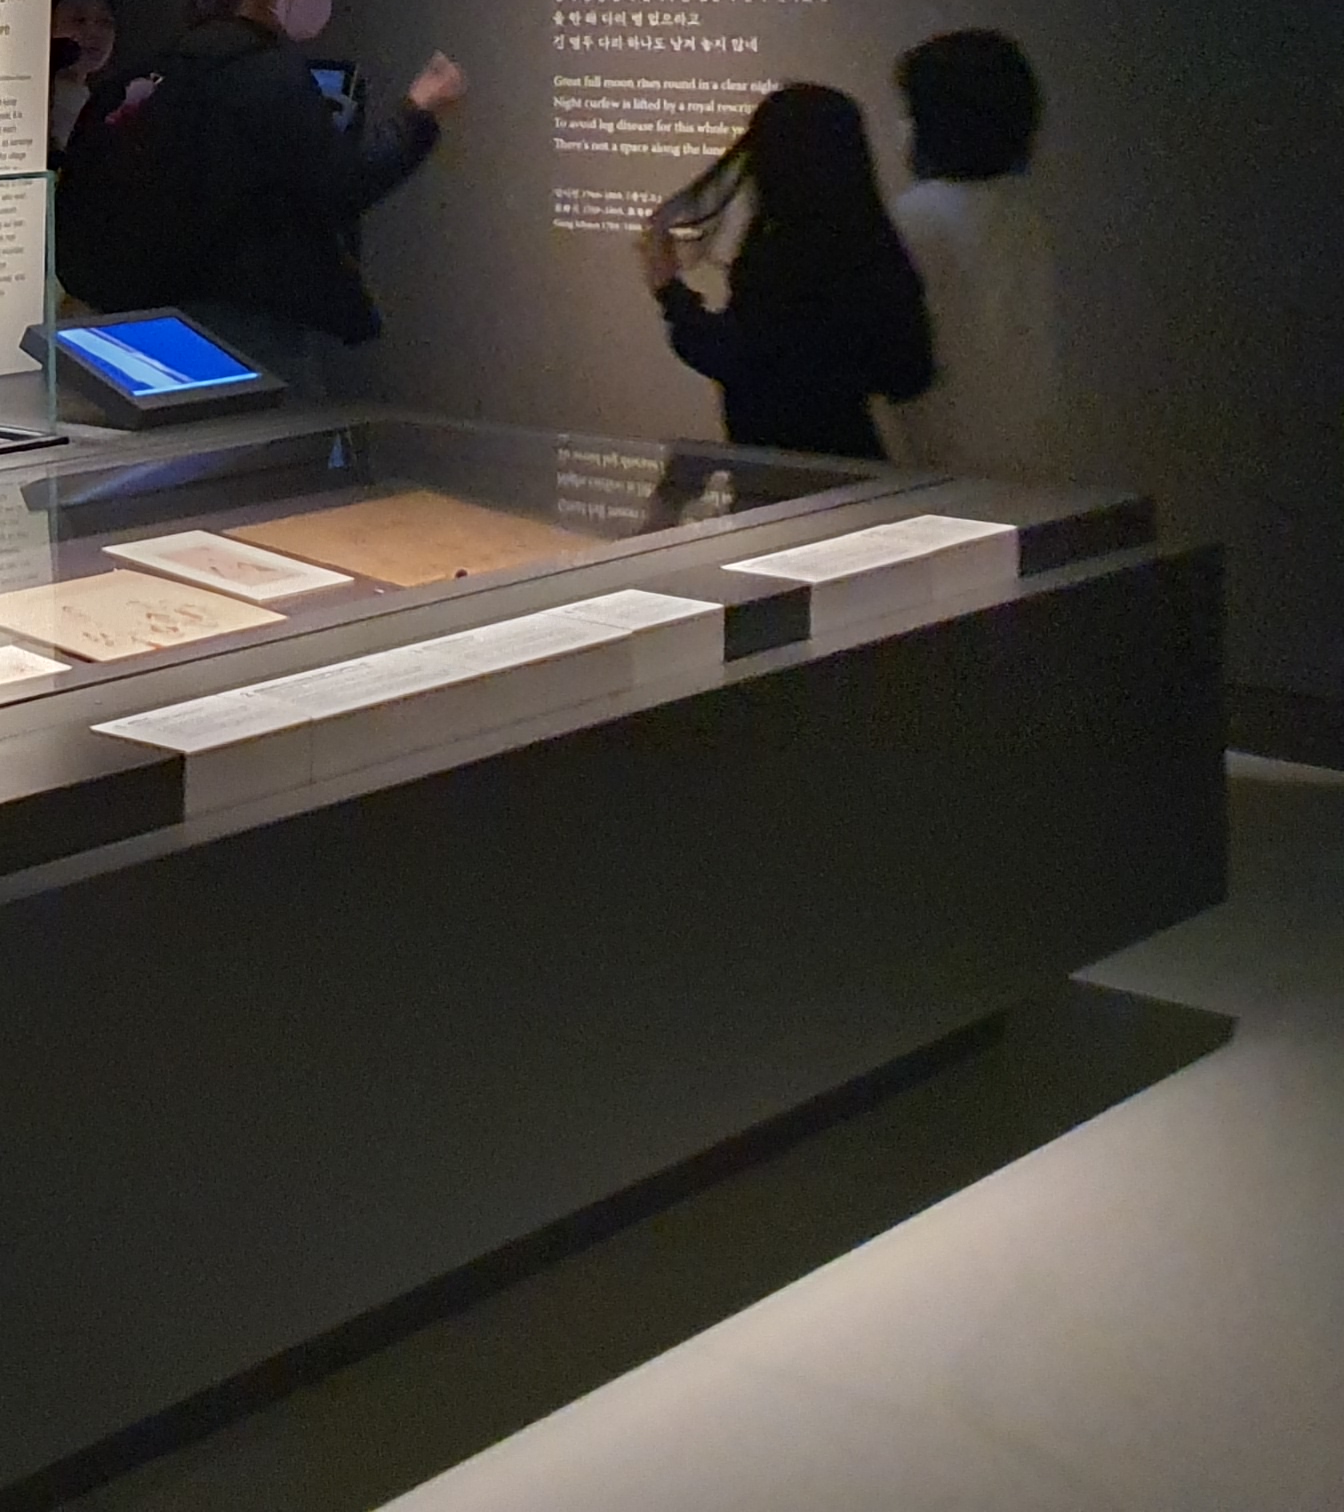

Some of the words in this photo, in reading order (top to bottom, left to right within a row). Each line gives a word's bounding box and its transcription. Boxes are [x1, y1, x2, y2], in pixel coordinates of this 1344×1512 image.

[598, 35, 623, 50] 다리
[627, 35, 666, 50] 하나도
[554, 75, 581, 87] Great
[584, 75, 601, 87] full
[604, 79, 634, 88] moon
[663, 77, 696, 90] round
[698, 78, 710, 90] in
[720, 78, 747, 90] clear
[553, 96, 582, 110] Night
[584, 96, 620, 109] curfew
[633, 98, 661, 110] lifted
[663, 99, 676, 114] by
[687, 100, 715, 114] royal
[554, 117, 567, 128] To
[568, 118, 597, 129] avoid
[616, 119, 654, 131] disease
[656, 119, 672, 132] for
[674, 121, 695, 133] this
[697, 121, 729, 134] whole
[553, 137, 590, 150] There's
[619, 143, 649, 155] space
[683, 143, 700, 155] the
